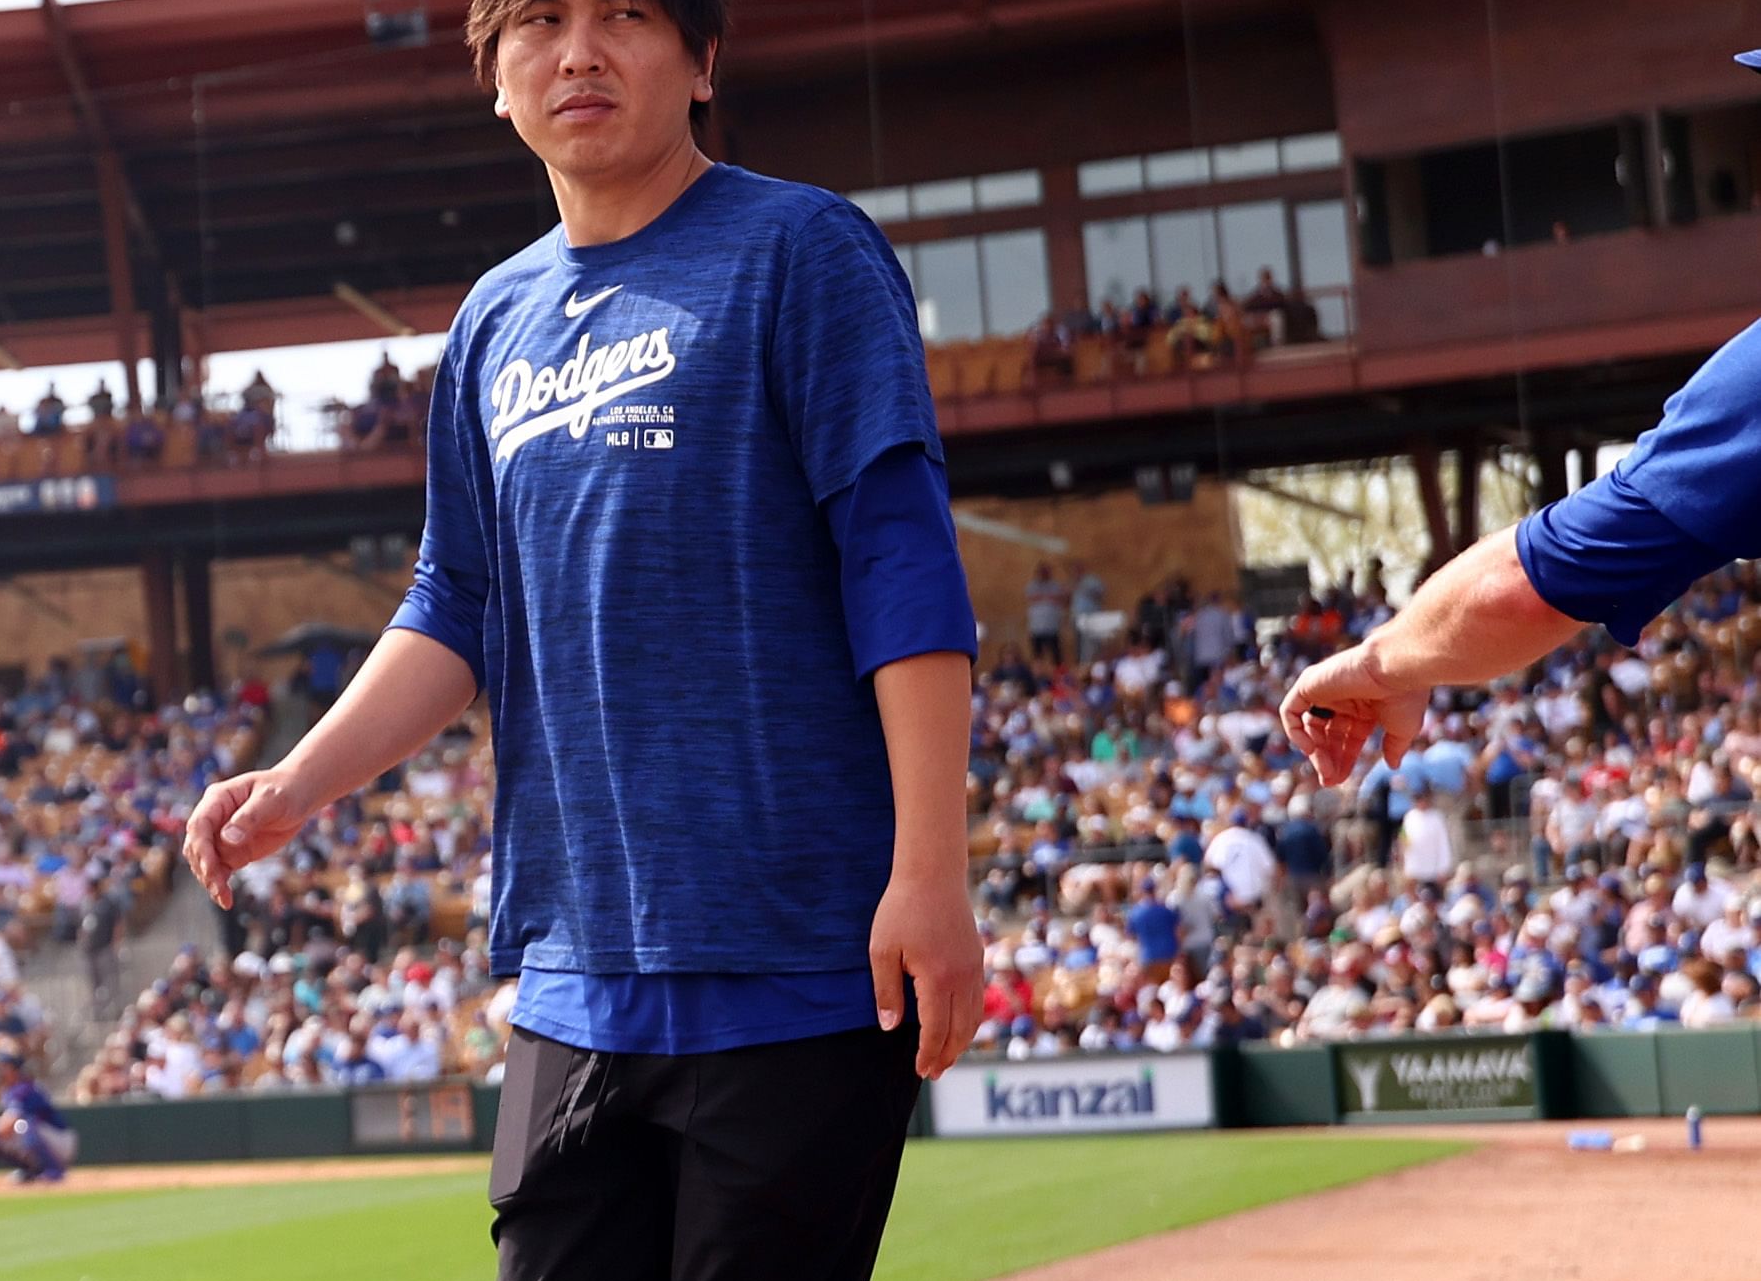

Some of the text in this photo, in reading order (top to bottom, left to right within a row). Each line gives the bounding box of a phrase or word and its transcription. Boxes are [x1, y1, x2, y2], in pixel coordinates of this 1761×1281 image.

[491, 327, 676, 462] Dodgers
[609, 405, 624, 416] LOS
[662, 405, 675, 415] CA
[627, 413, 675, 424] COLLECTION
[606, 431, 630, 447] MLB
